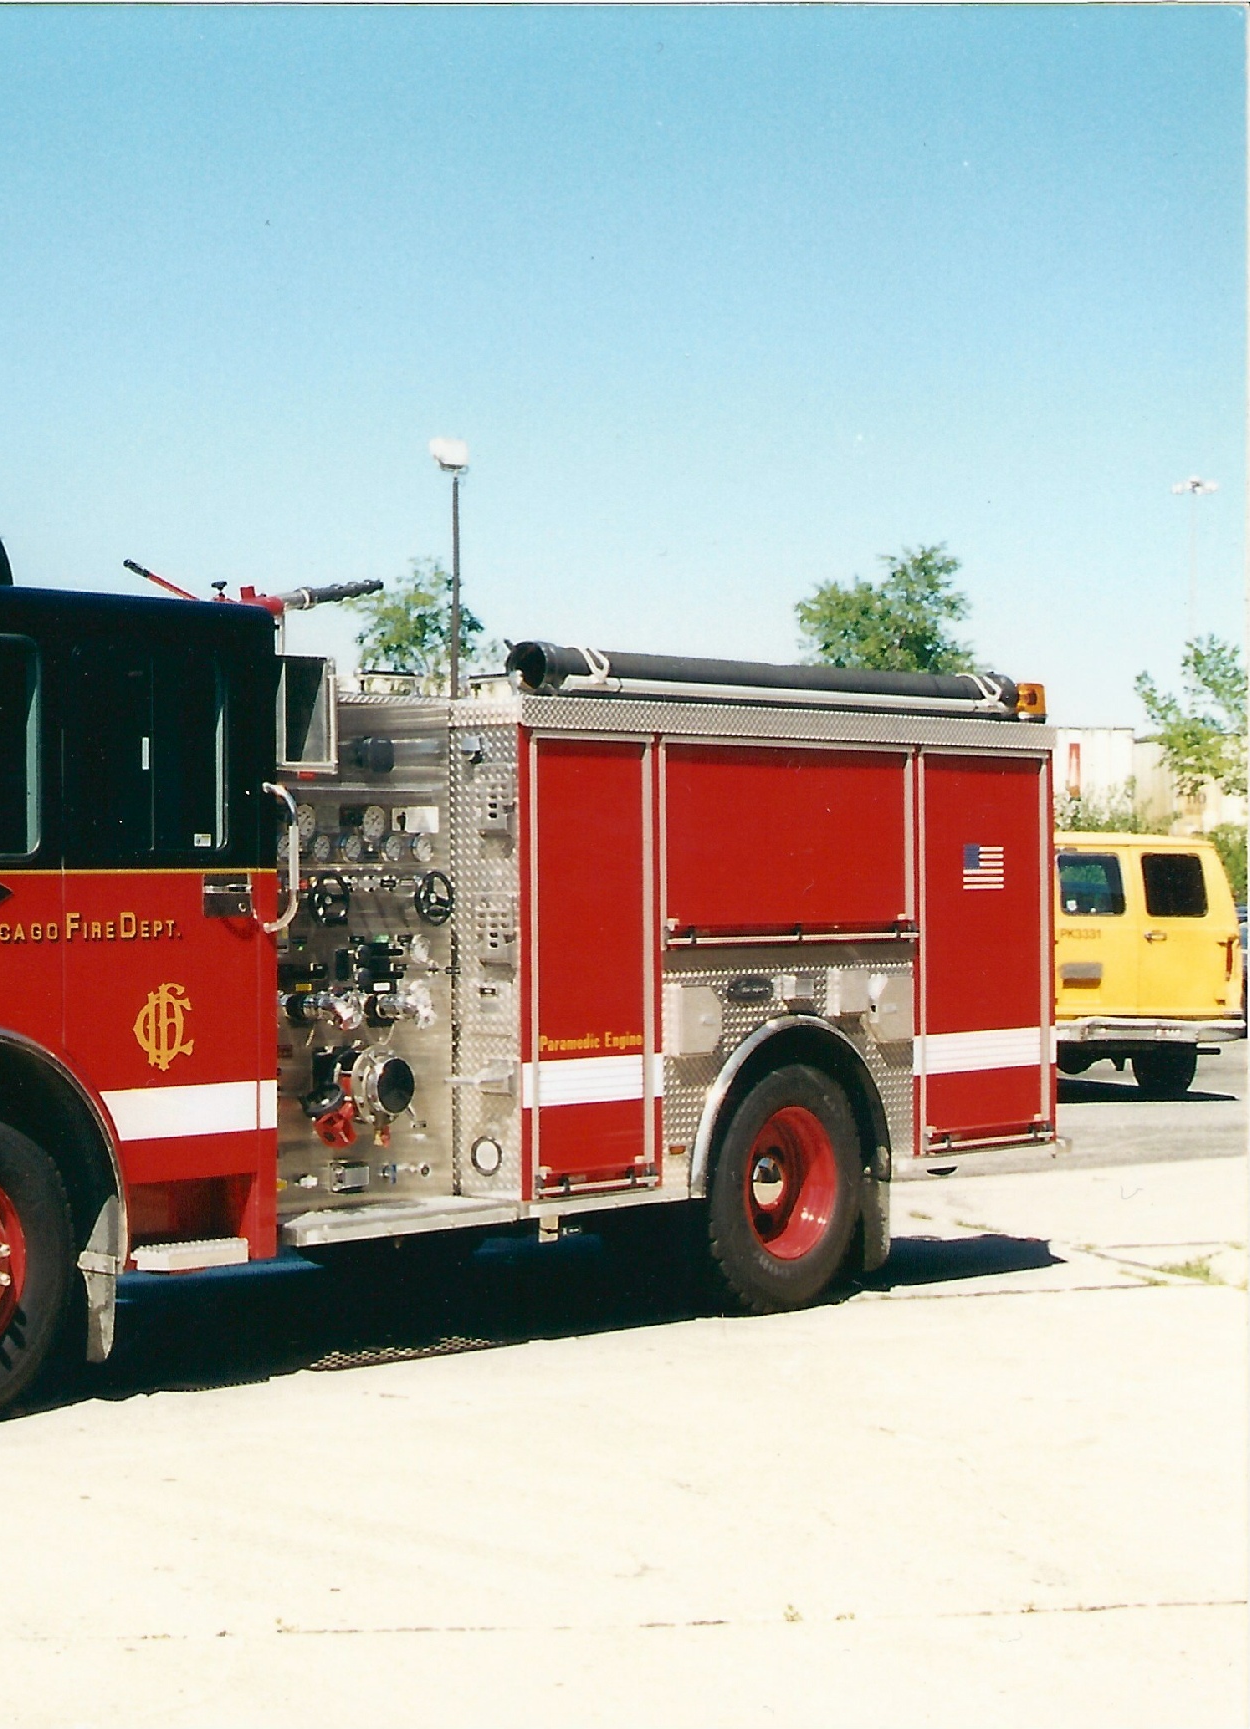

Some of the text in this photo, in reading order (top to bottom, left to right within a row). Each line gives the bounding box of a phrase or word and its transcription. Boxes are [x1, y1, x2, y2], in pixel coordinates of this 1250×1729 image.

[65, 911, 117, 941] FIRE
[119, 911, 182, 940] DEPT.
[539, 1031, 643, 1052] Paramedic Engine
